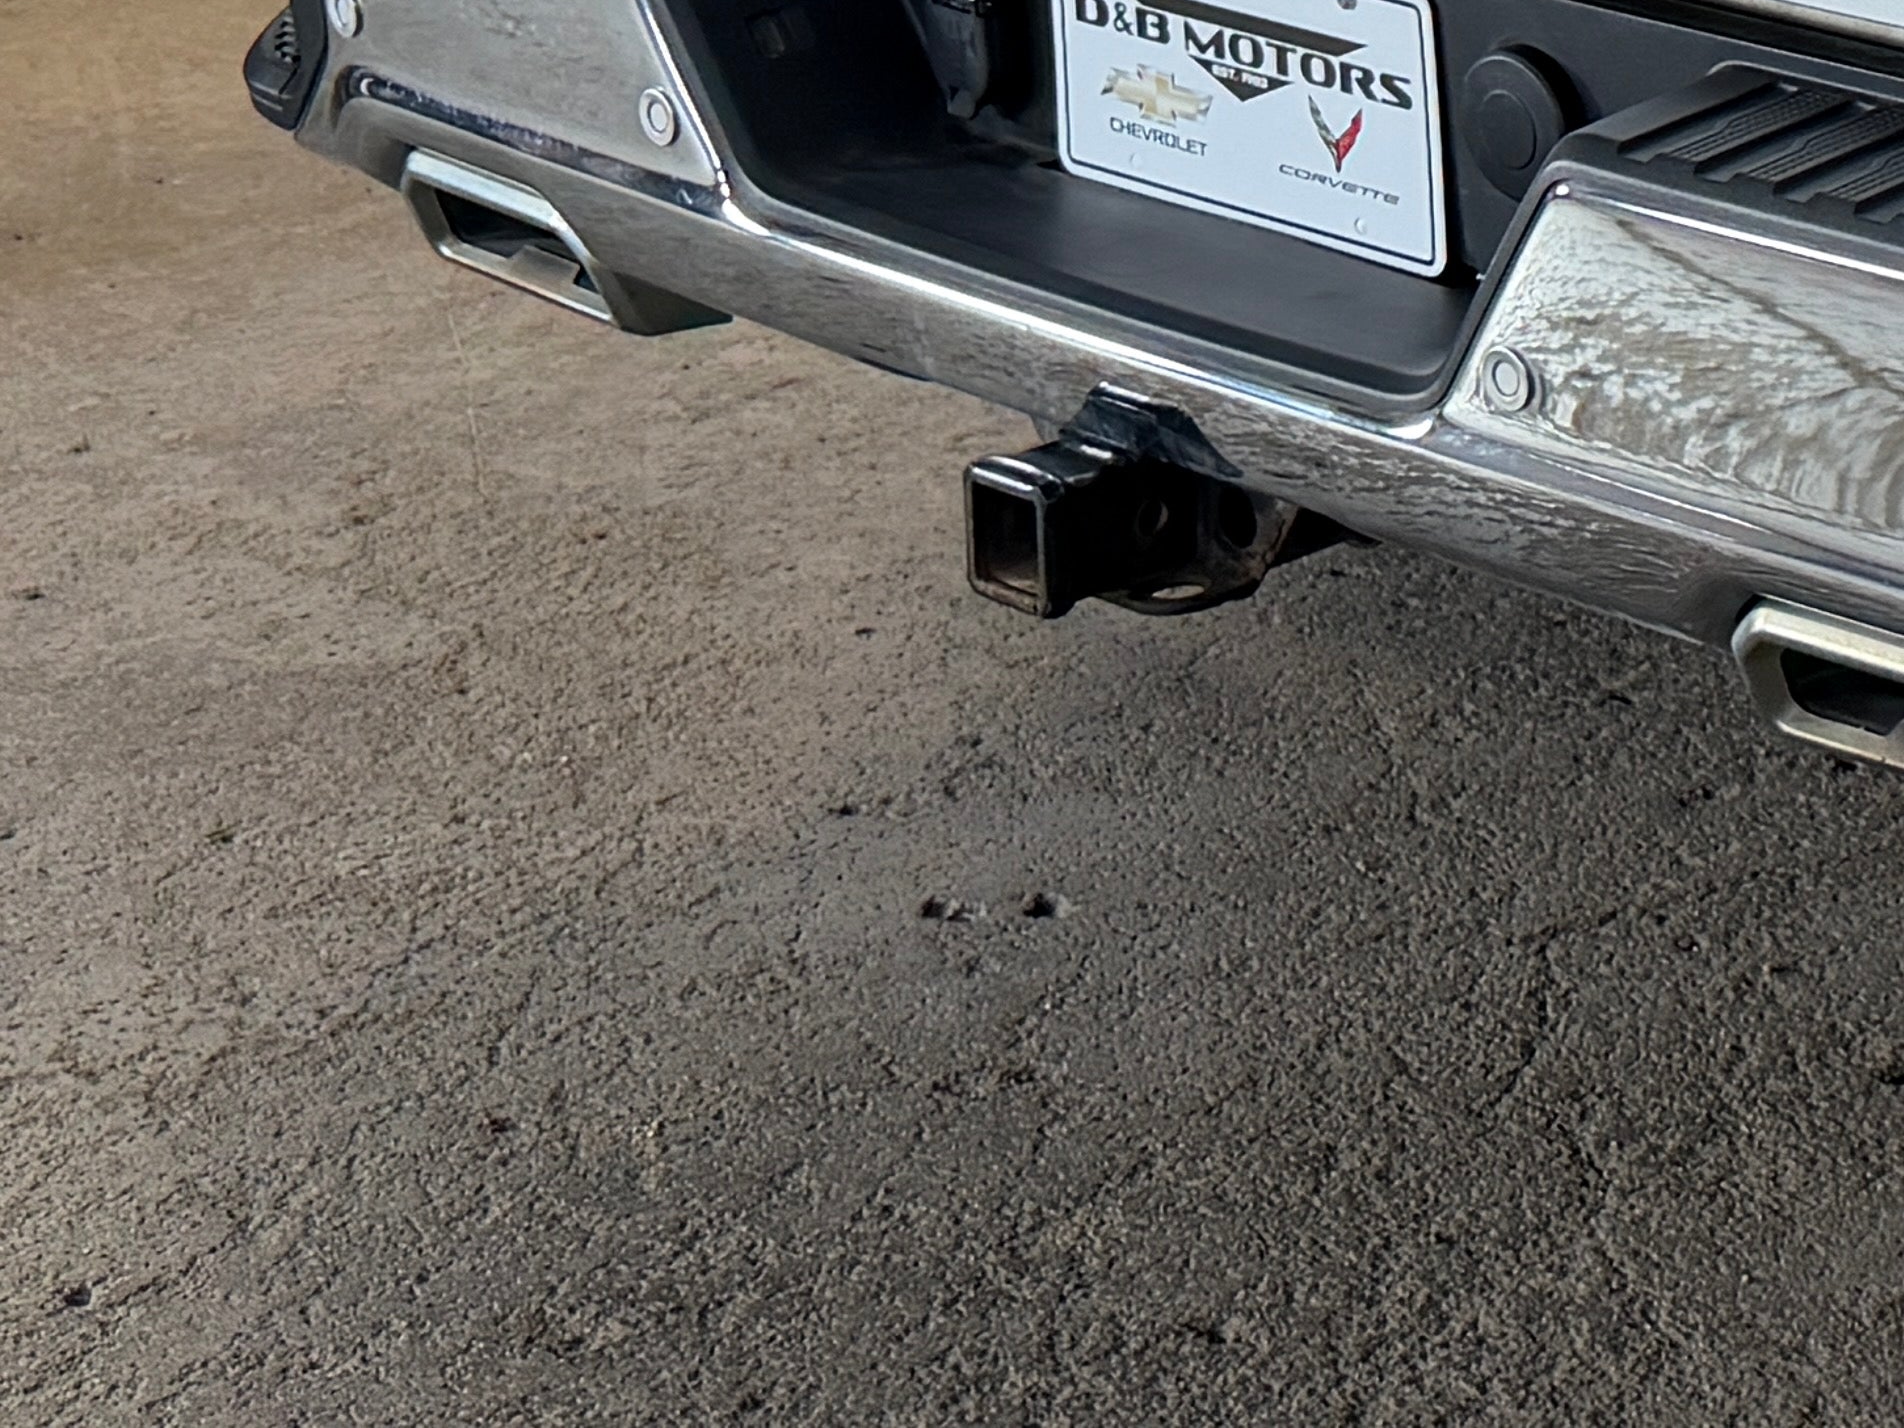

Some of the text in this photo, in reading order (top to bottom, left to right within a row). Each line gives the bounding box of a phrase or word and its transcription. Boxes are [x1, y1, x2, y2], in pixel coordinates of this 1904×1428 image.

[1184, 20, 1414, 111] MOTORS
[1109, 116, 1208, 157] CHEVROLET
[1278, 163, 1401, 206] CORVETTE
